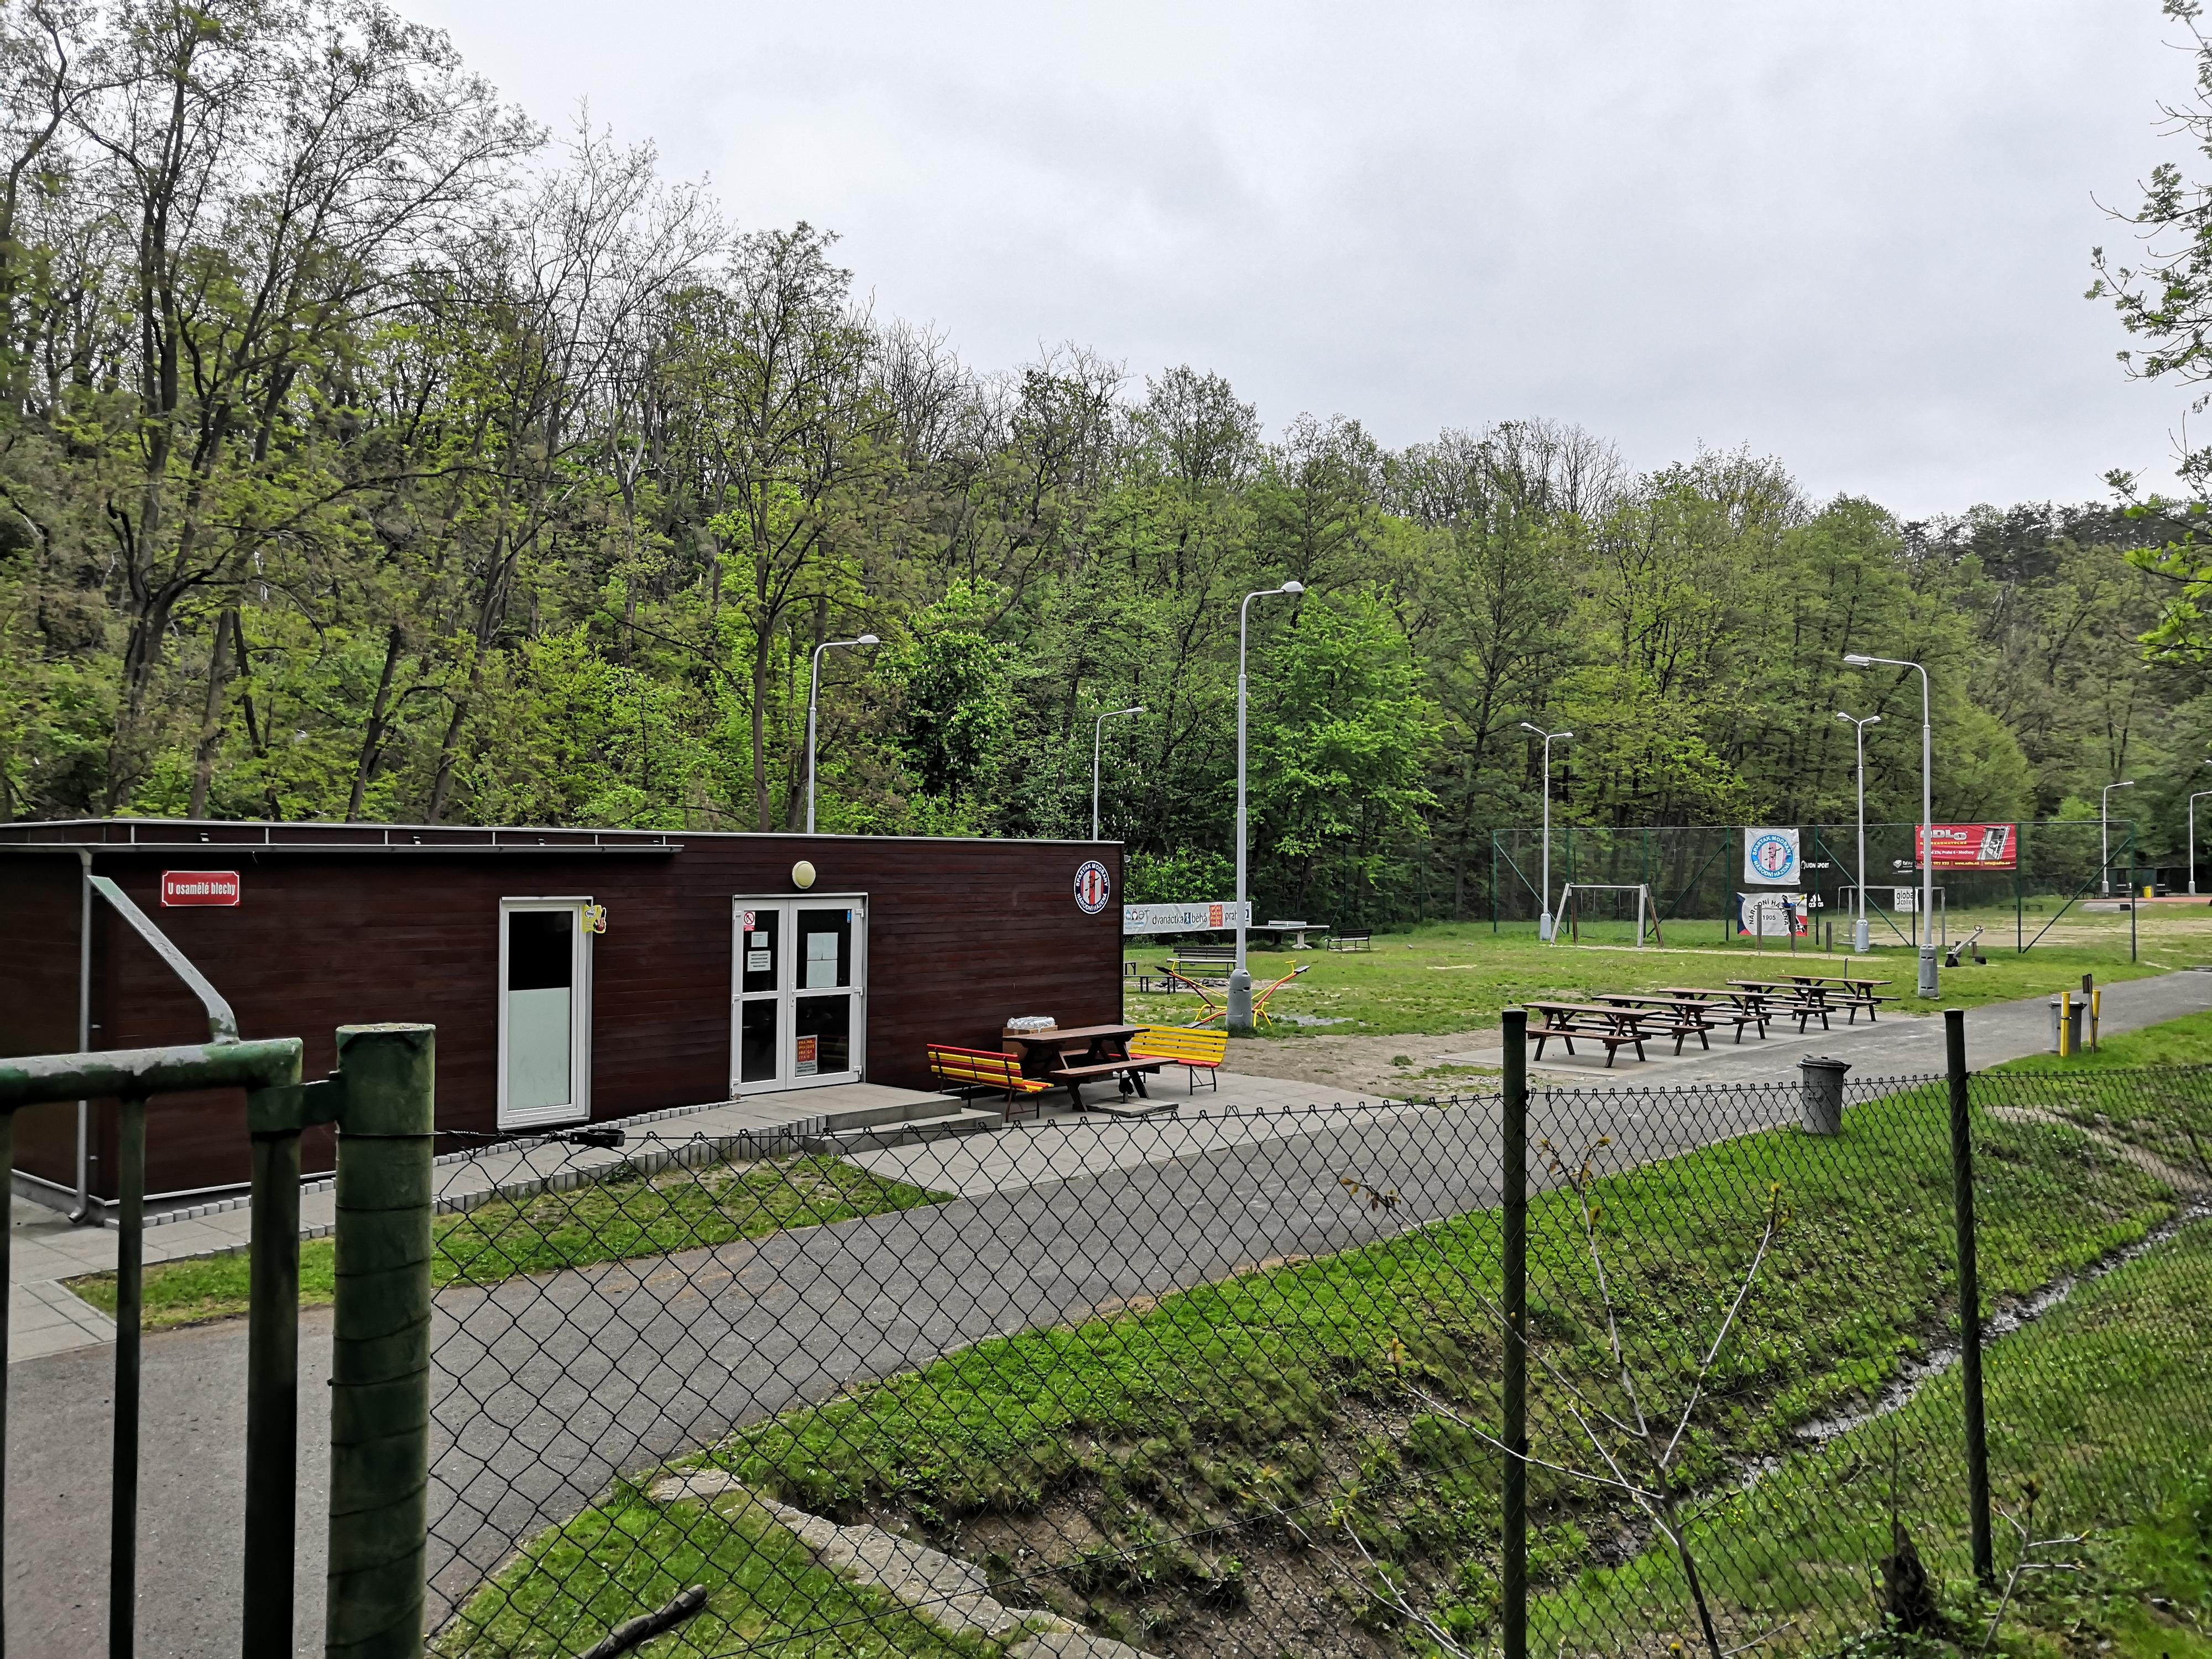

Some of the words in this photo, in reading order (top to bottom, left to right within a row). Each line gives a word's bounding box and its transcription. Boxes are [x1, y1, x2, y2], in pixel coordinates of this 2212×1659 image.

[1752, 836, 1771, 855] SPARTAK
[1076, 863, 1091, 886] SPARTAK
[168, 883, 174, 895] U
[176, 882, 209, 895] osamělé
[211, 883, 236, 895] blechy
[1152, 914, 1183, 925] dvanáctka
[1192, 912, 1207, 923] běhá
